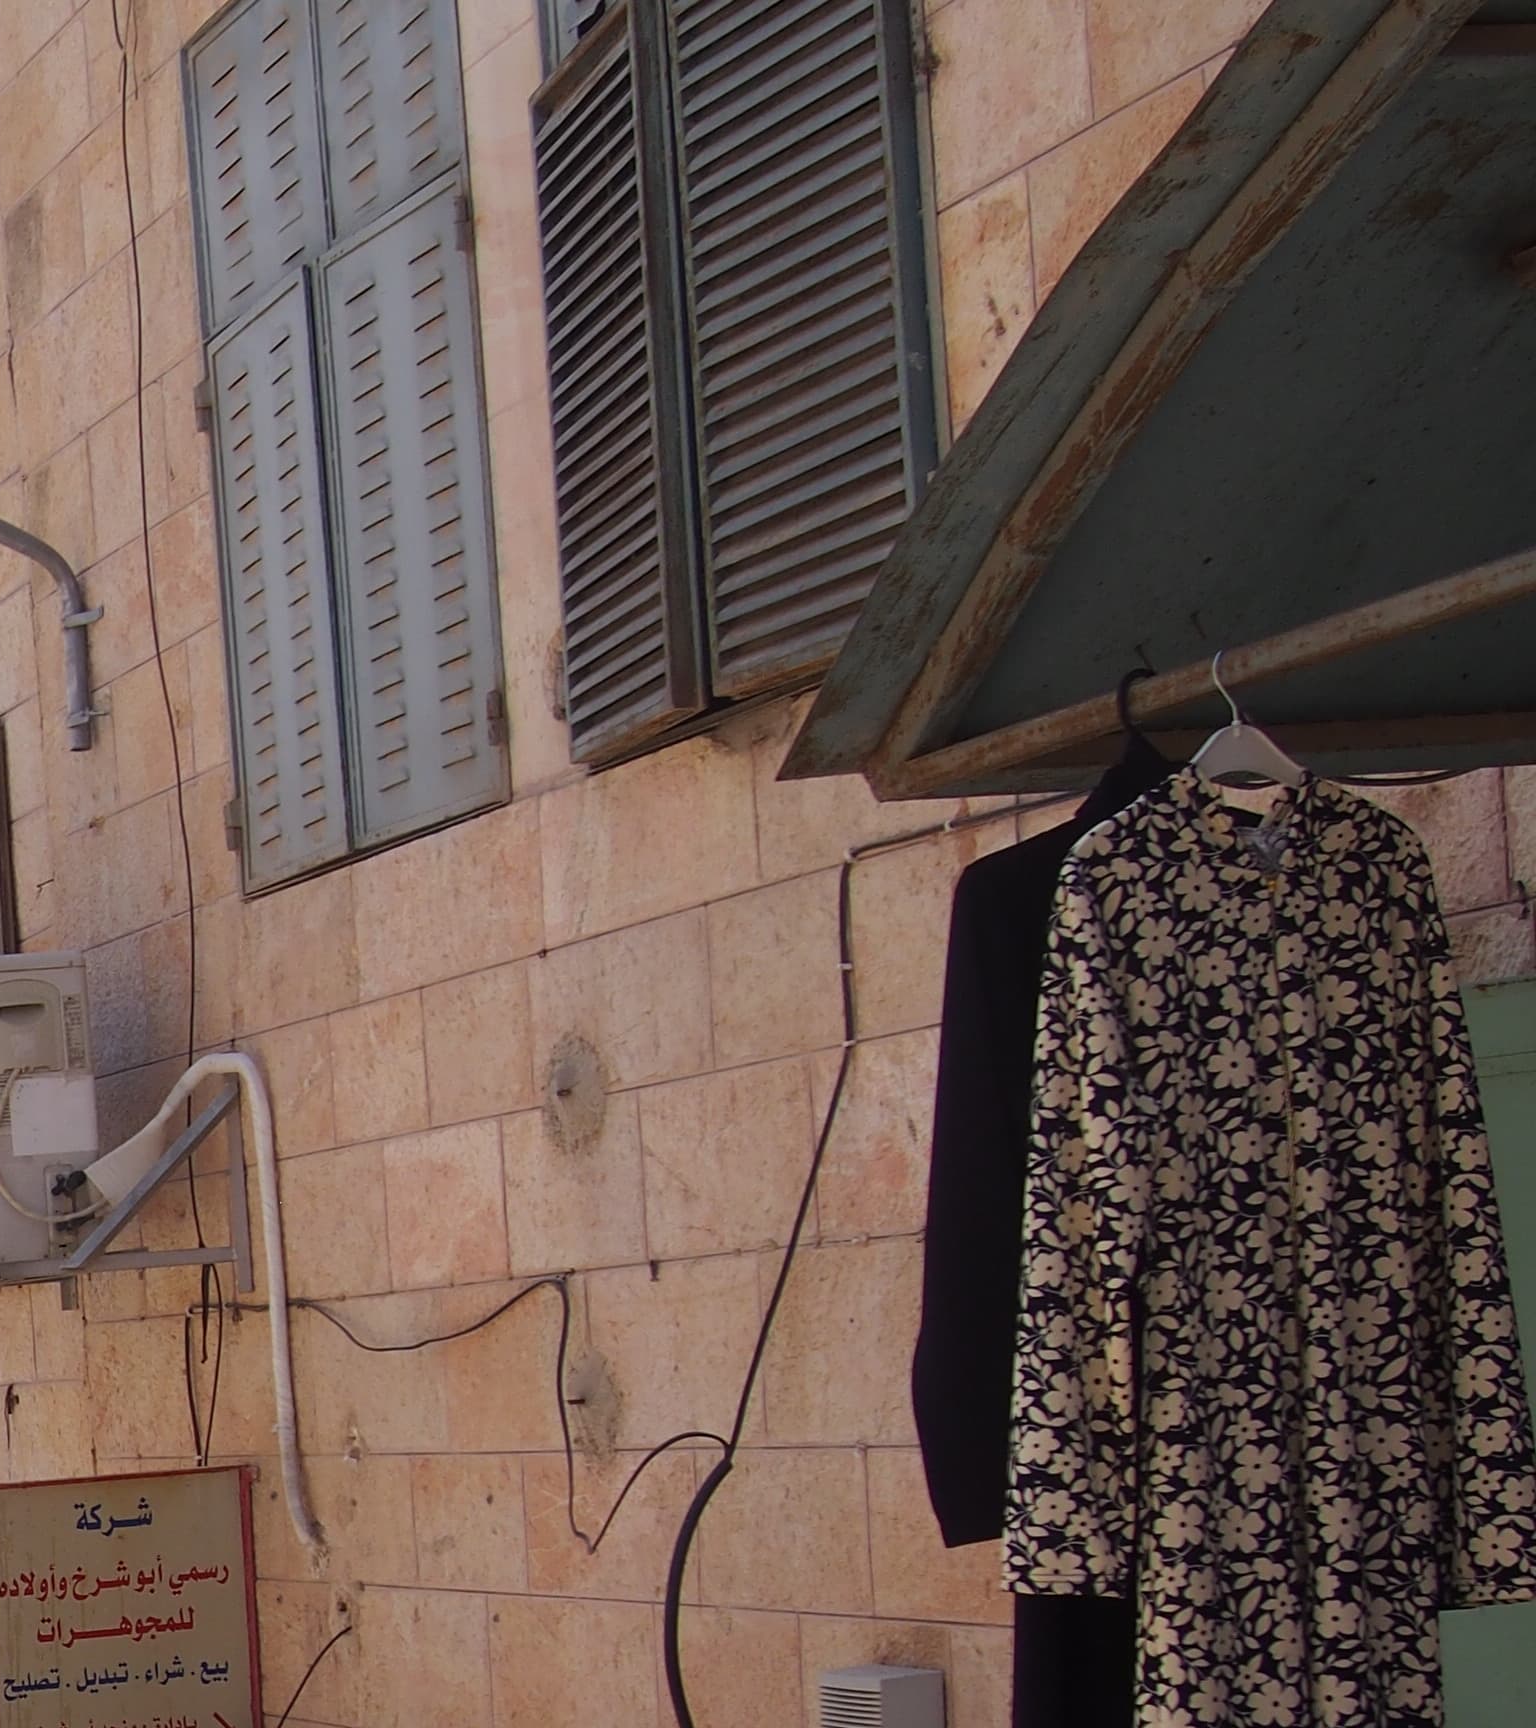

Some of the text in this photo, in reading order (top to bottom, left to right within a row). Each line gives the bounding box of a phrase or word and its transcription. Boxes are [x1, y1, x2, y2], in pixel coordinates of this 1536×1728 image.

[74, 1497, 153, 1536] شركة
[71, 1561, 130, 1600] شرخ
[134, 1555, 163, 1594] أبو
[168, 1562, 229, 1594] رسمي
[37, 1606, 194, 1647] للمجوهرات
[3, 1656, 229, 1700] بيع شراء تبديل تصليح
